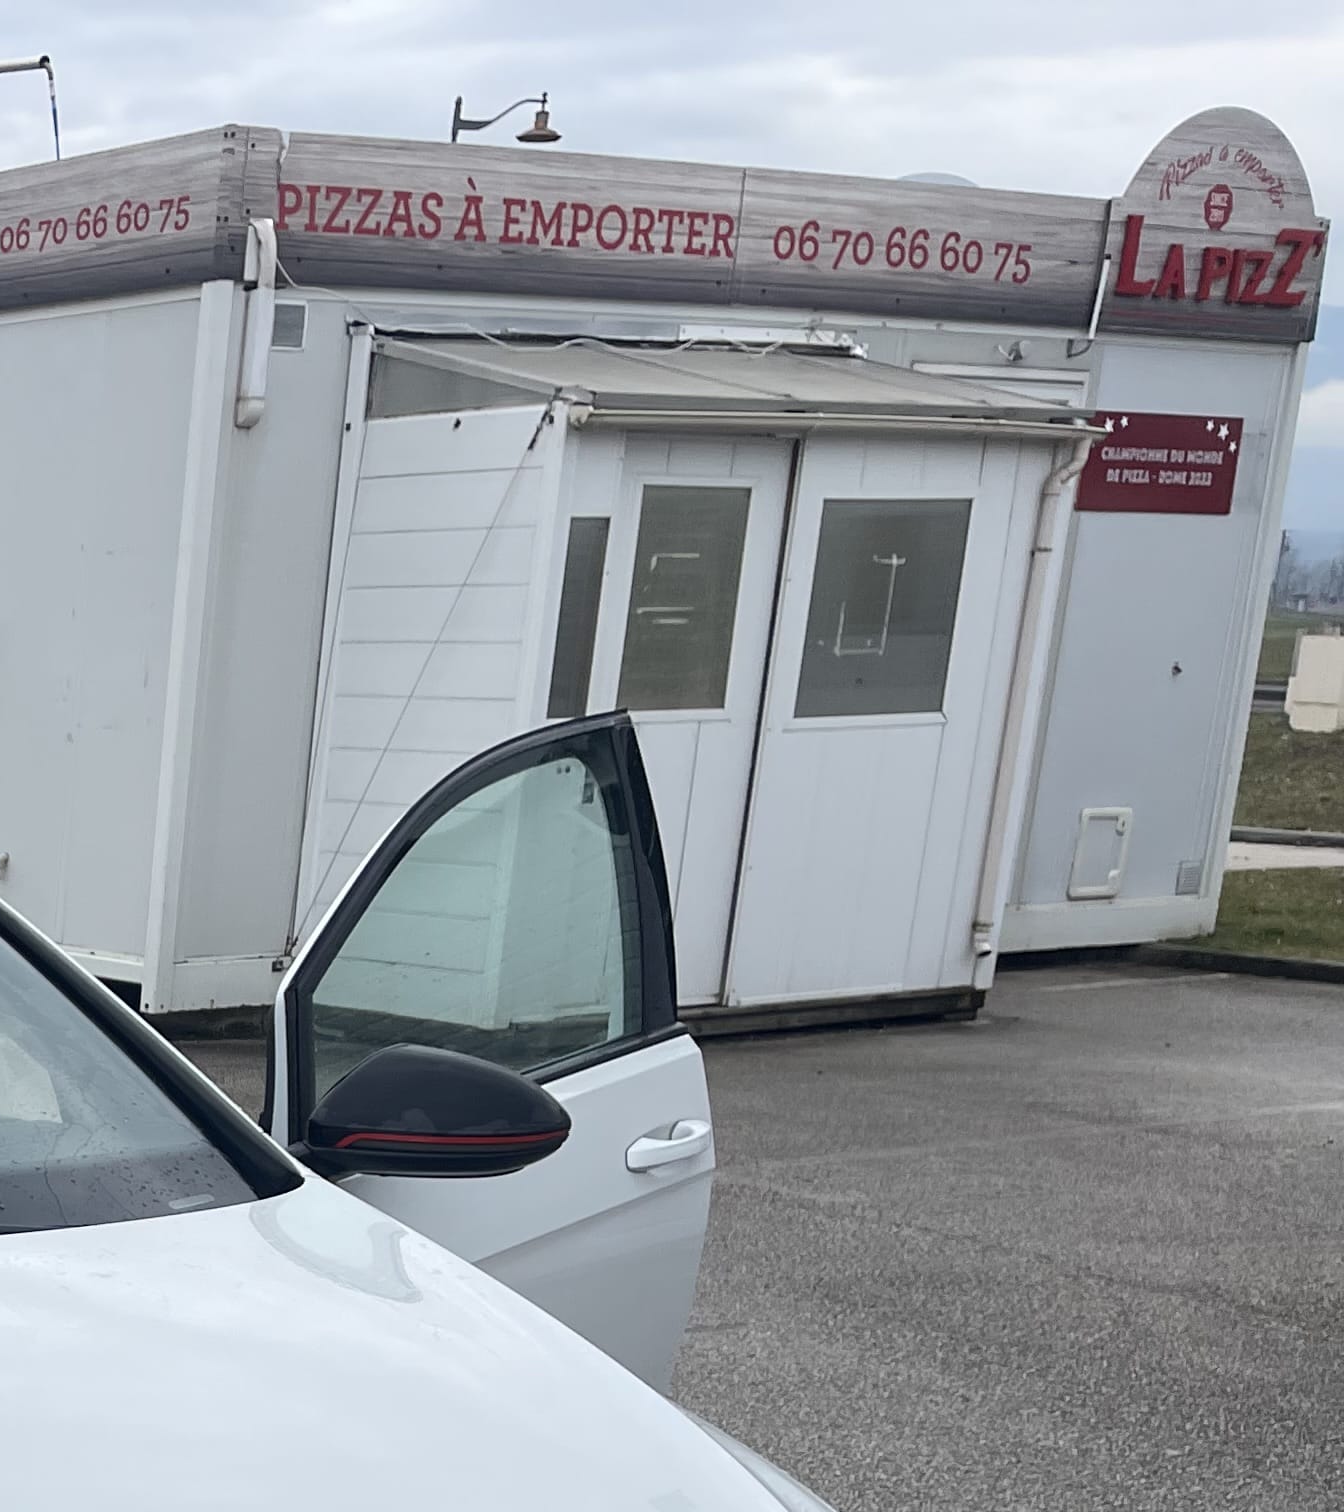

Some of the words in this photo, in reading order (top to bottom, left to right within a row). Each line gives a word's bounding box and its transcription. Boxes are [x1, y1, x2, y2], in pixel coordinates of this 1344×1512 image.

[0, 217, 31, 254] 06
[38, 217, 68, 252] 70
[76, 204, 108, 241] 66
[116, 199, 150, 235] 60
[159, 195, 191, 233] 75
[277, 182, 444, 240] PIZZAS
[454, 176, 488, 242] À
[499, 197, 736, 258] EMPORTER
[772, 220, 820, 262] 06
[831, 229, 874, 270] 70
[885, 226, 930, 270] 66
[940, 231, 984, 274] 60
[993, 242, 1033, 285] 75
[1115, 214, 1185, 299] LA
[1106, 468, 1121, 483] DE
[1122, 468, 1150, 484] PIZZA
[1170, 449, 1186, 463] DU
[1187, 450, 1224, 465] MONDE
